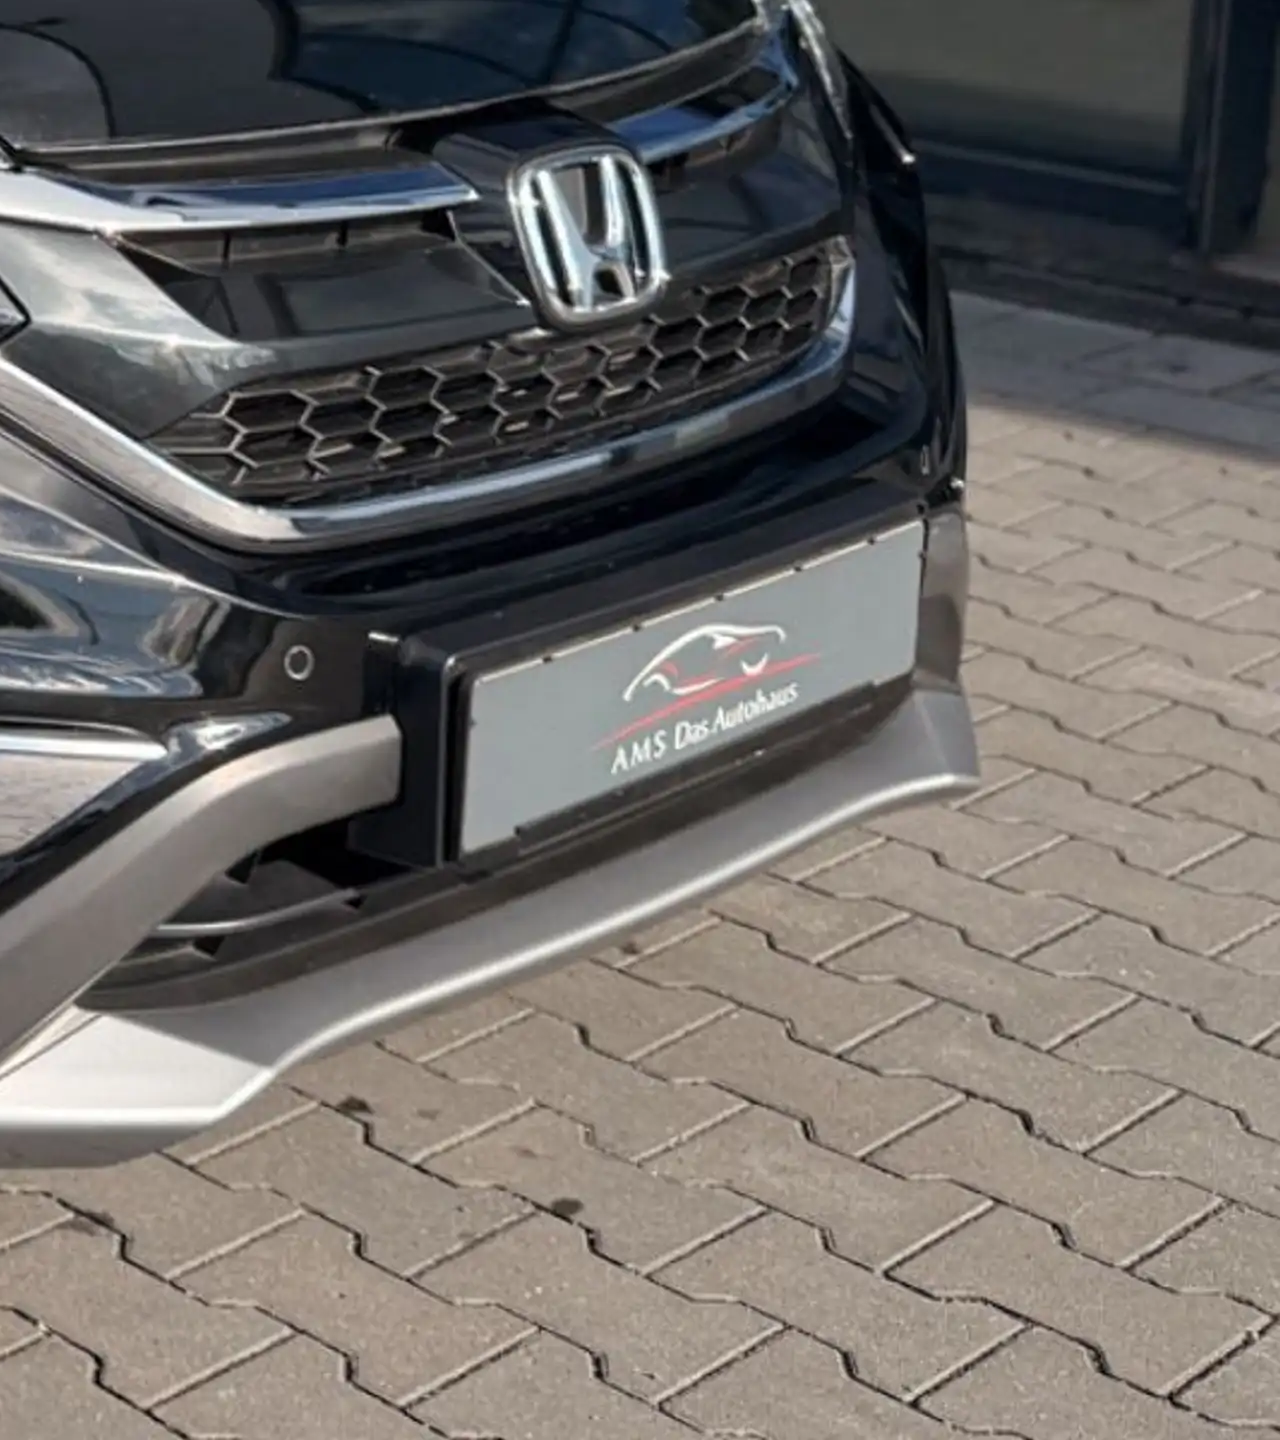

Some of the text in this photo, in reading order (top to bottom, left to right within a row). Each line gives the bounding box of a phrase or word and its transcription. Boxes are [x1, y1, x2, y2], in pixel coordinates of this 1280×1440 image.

[610, 681, 799, 775] AMS Das Autohaus
